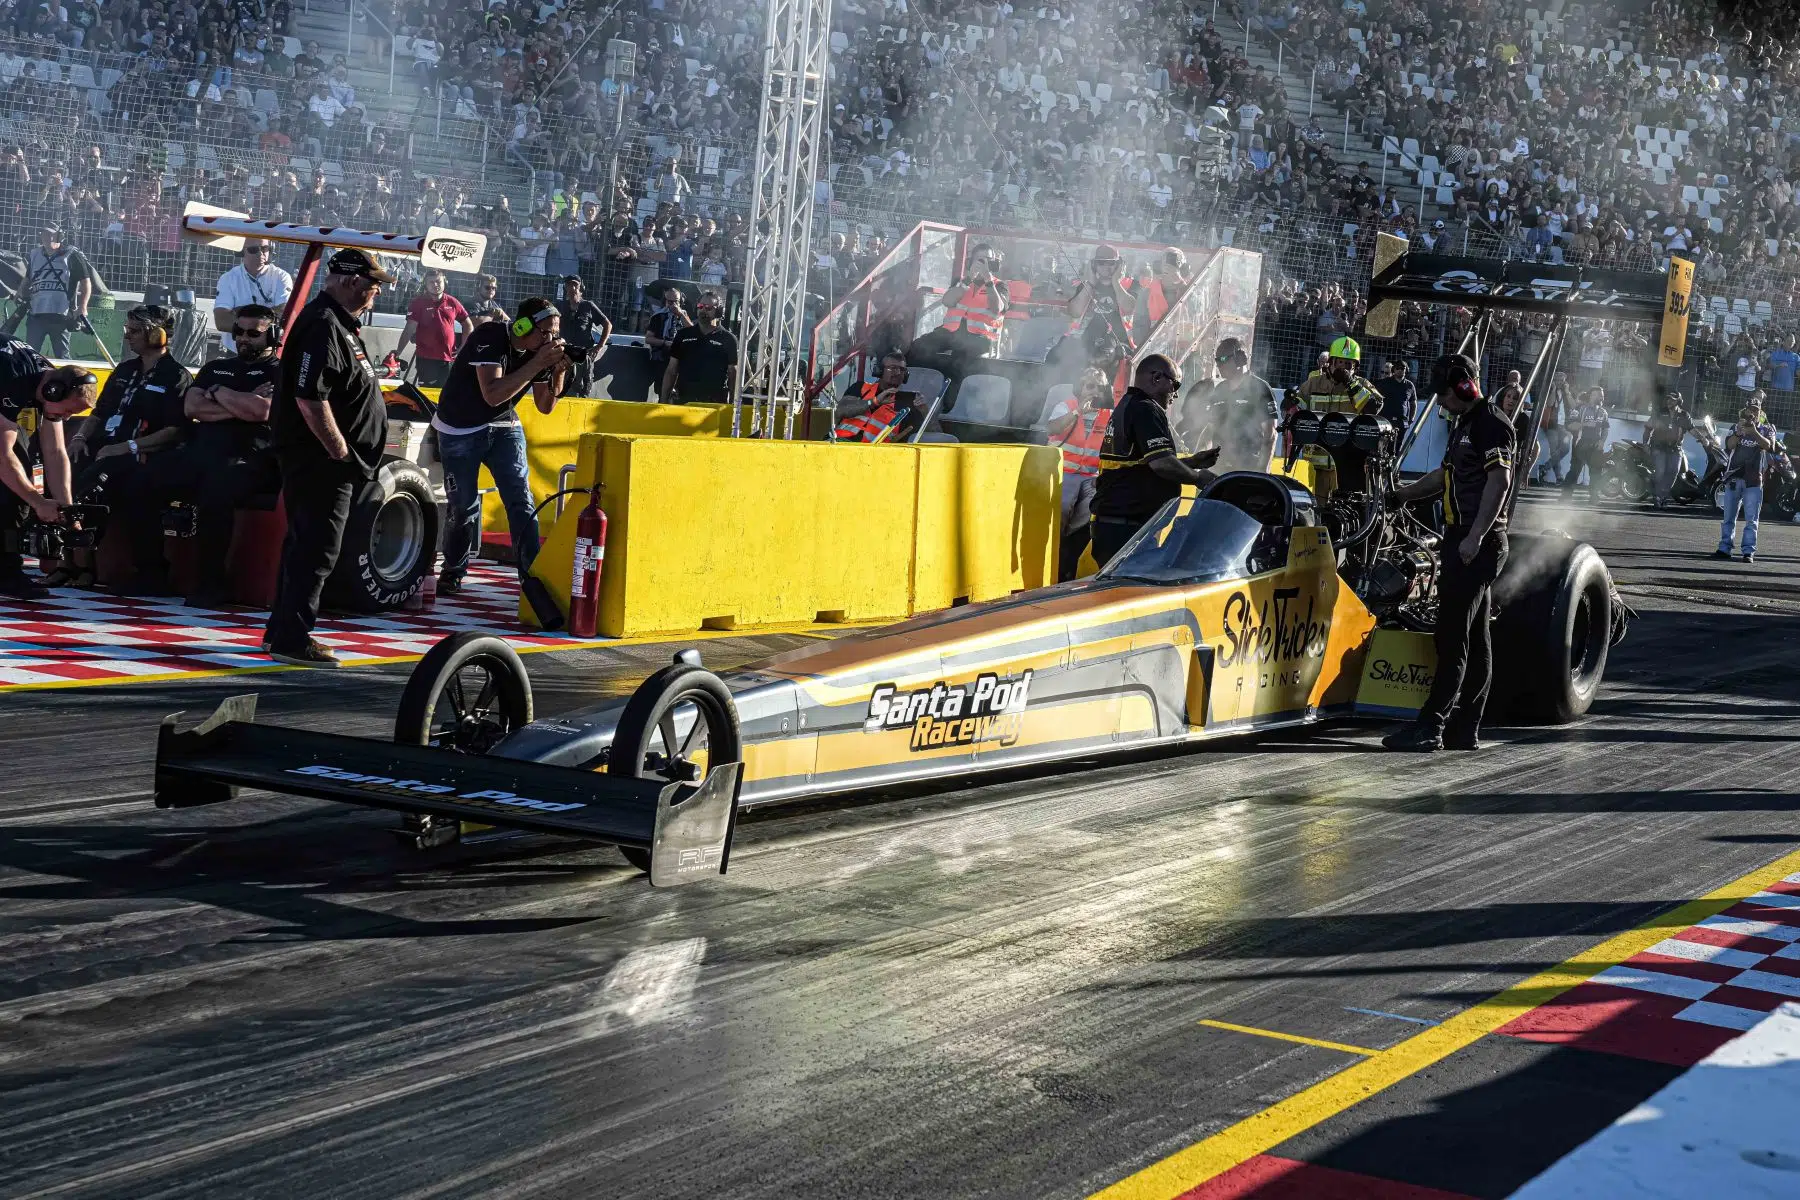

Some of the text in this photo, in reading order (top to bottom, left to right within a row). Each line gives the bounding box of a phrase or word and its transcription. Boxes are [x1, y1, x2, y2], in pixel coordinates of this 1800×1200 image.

[1671, 263, 1679, 280] TF
[358, 552, 424, 604] GOODYEAR
[1235, 670, 1301, 692] RCING
[865, 672, 1034, 728] Santa Pod
[911, 713, 1024, 748] Raceway
[284, 765, 587, 812] Santa Pod
[679, 846, 722, 866] RF
